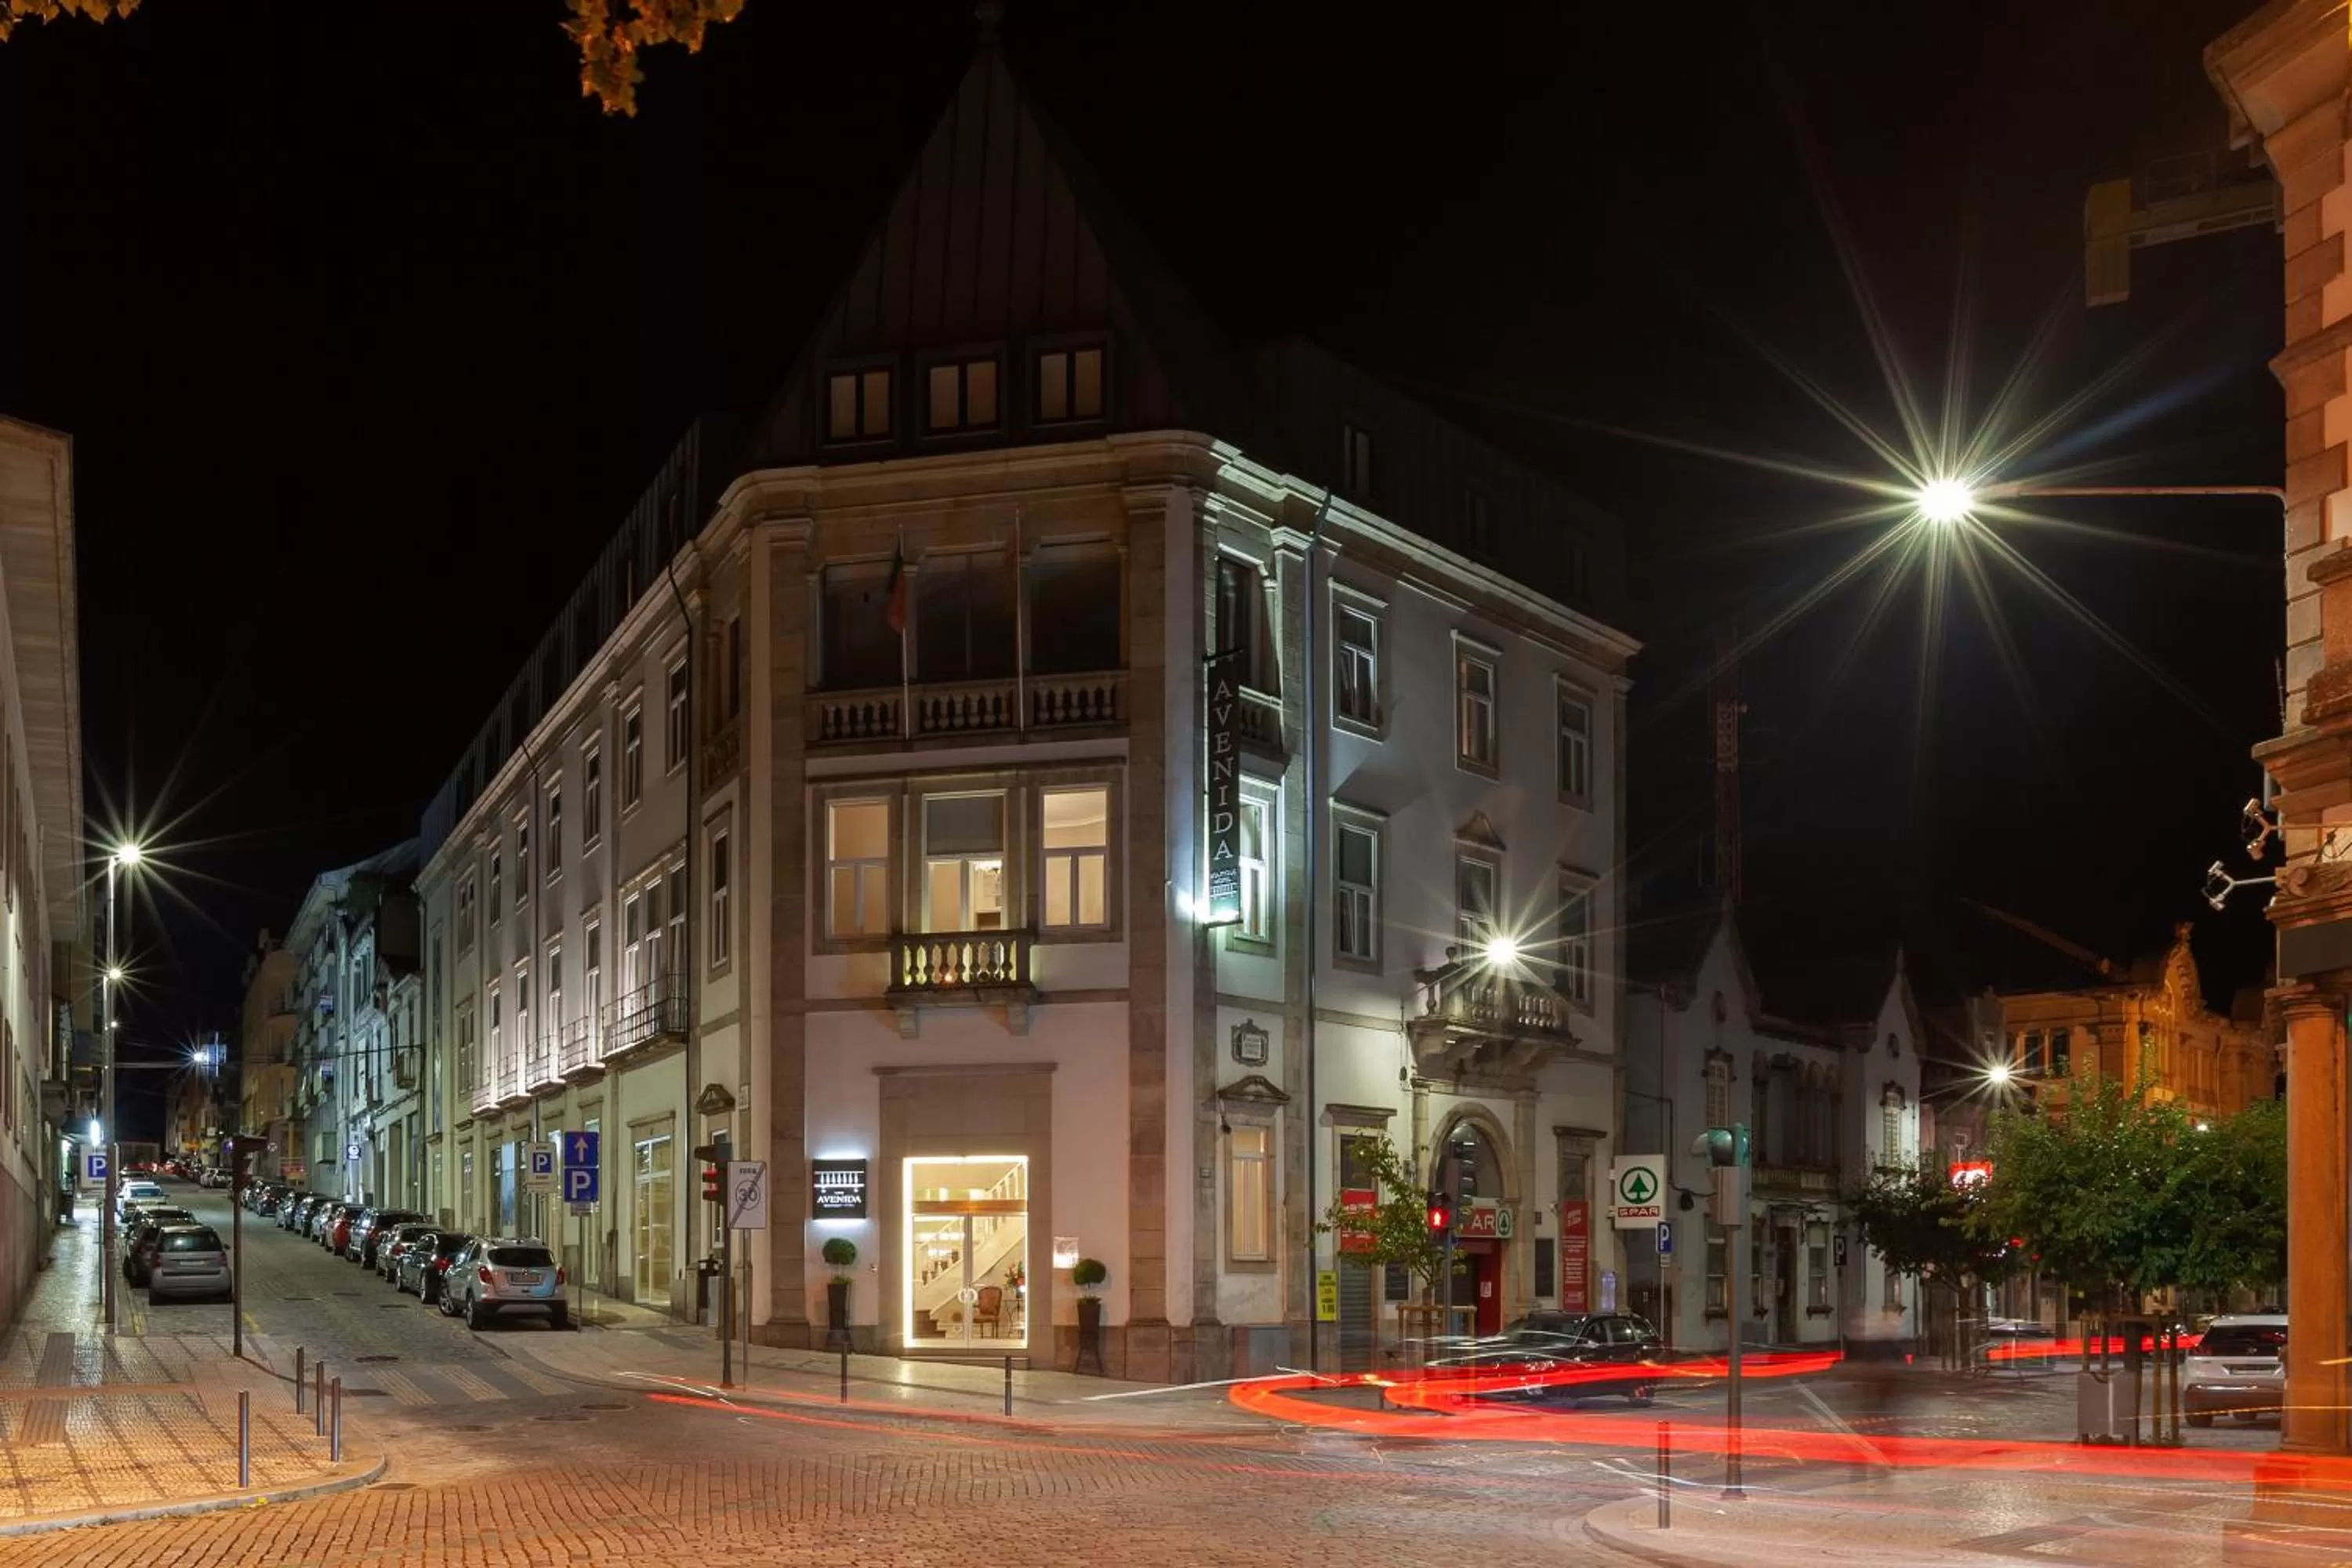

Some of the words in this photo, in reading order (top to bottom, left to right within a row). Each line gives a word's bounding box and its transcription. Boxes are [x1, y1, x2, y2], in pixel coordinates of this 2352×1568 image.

[1213, 679, 1234, 861] AVENIDA
[93, 1156, 106, 1176] P
[535, 1154, 548, 1171] P
[571, 1171, 591, 1199] P
[739, 1188, 757, 1202] 30
[816, 1195, 862, 1203] AVENIDA
[1619, 1207, 1658, 1216] SPAR
[1660, 1225, 1669, 1250] P
[1835, 1239, 1845, 1264] P
